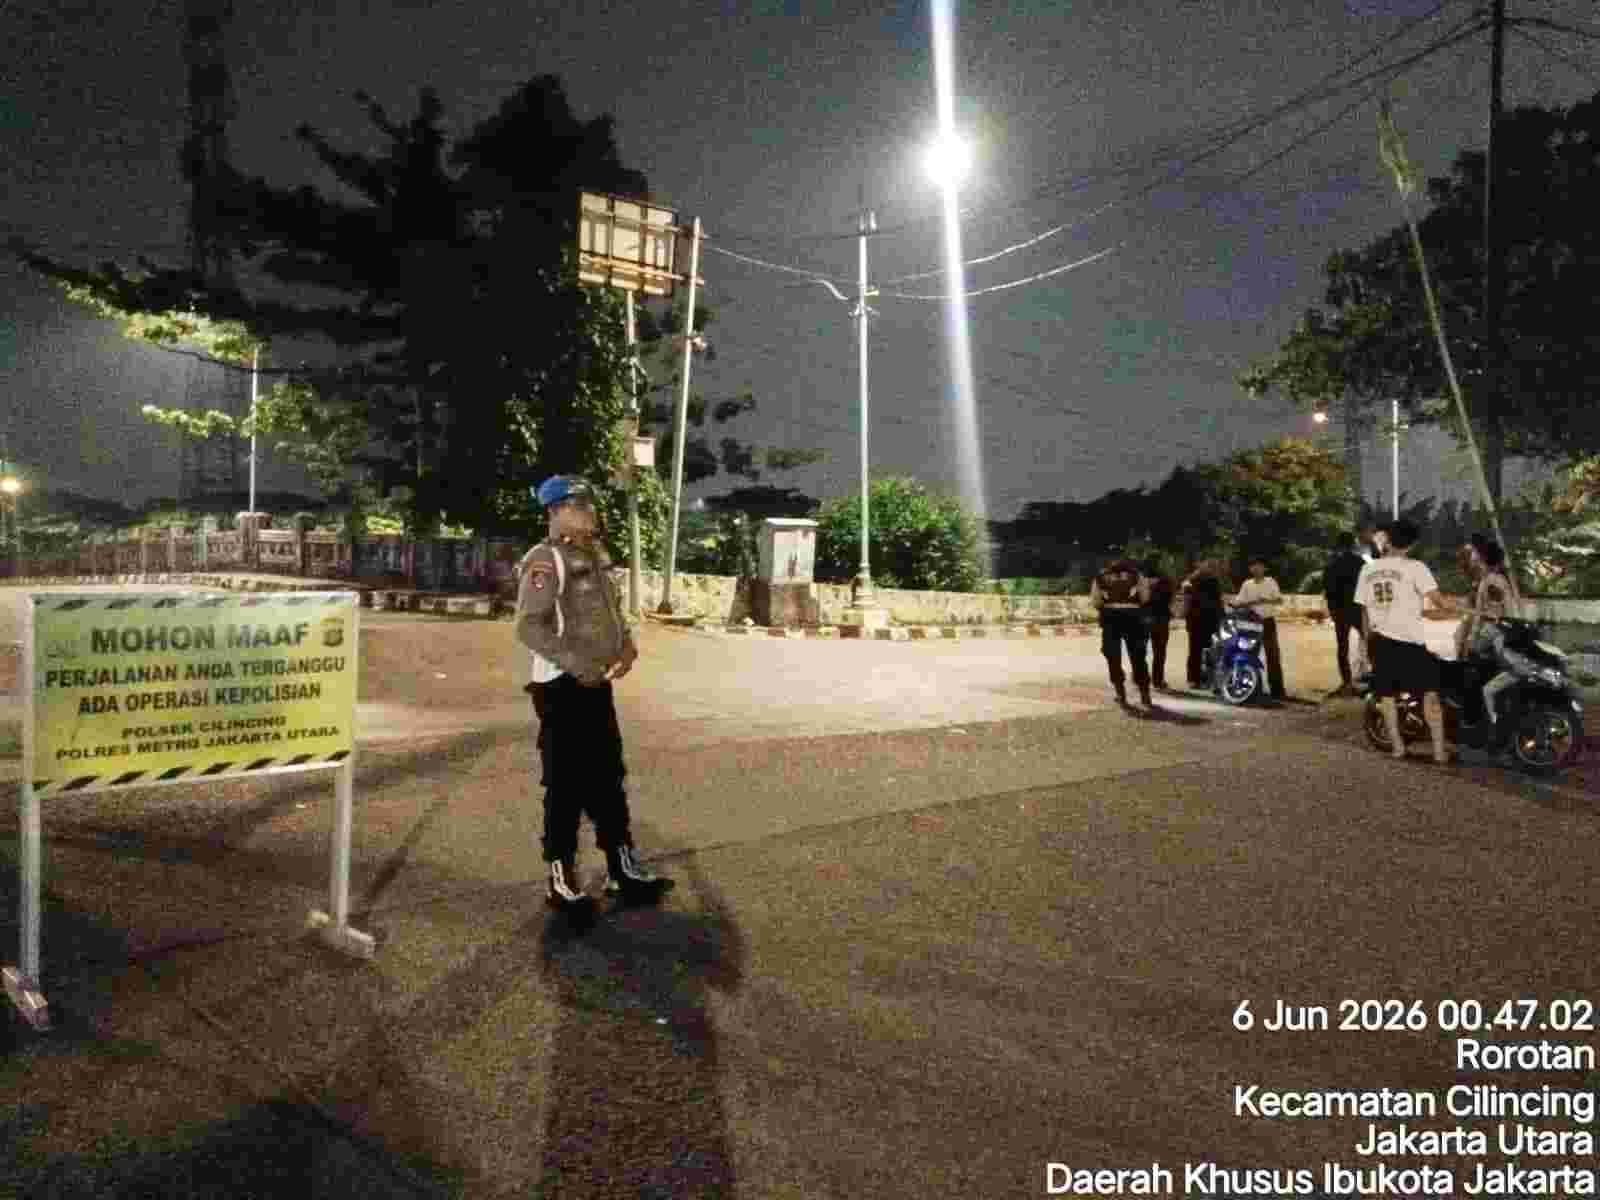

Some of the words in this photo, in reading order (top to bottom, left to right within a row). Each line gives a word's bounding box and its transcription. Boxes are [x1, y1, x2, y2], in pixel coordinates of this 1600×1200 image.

[91, 626, 215, 654] MOHON
[227, 622, 309, 648] MAAF
[45, 663, 178, 689] PERJALANAN
[185, 659, 235, 681] ANDA
[241, 655, 346, 679] TERGANGGU
[78, 695, 120, 716] ADA
[126, 690, 209, 712] OPERASI
[215, 682, 322, 705] KEPOLISIAN
[56, 744, 131, 761] POLRES
[136, 737, 200, 753] METRO
[205, 731, 282, 747] JAKARTA
[287, 726, 340, 740] UTARA
[121, 724, 194, 740] POLSEK
